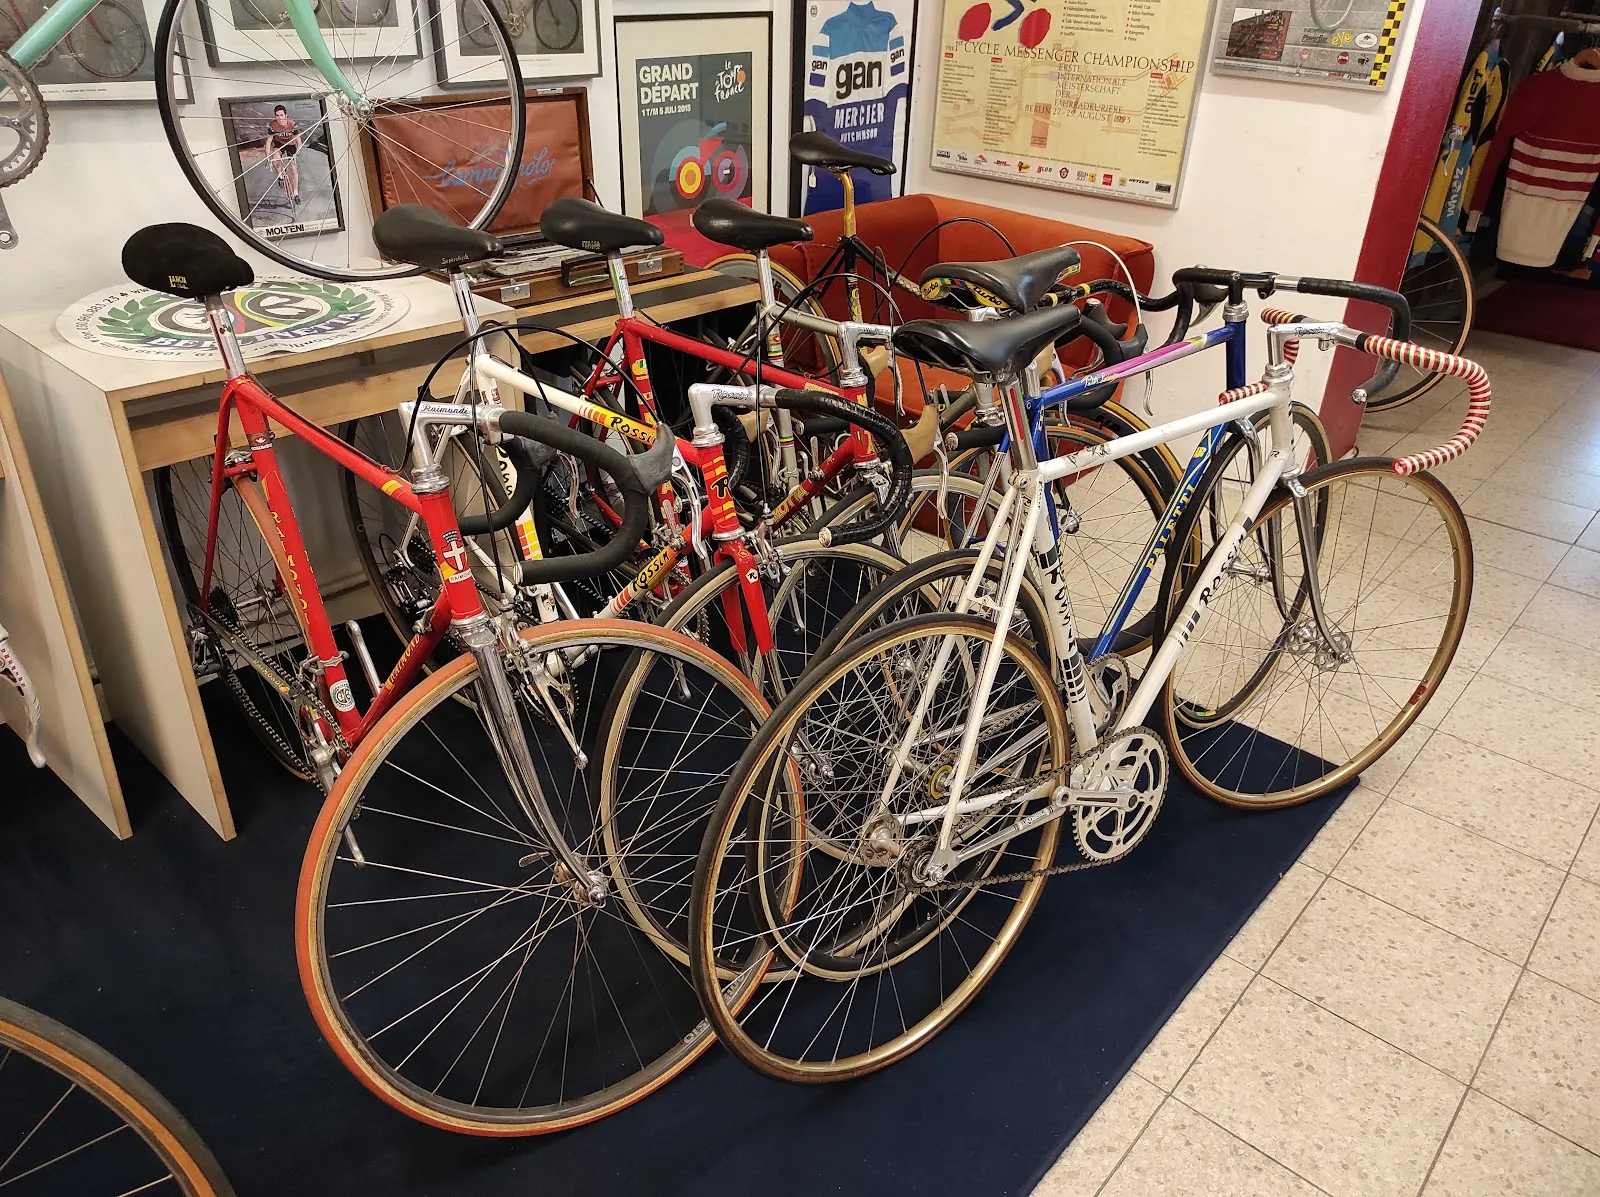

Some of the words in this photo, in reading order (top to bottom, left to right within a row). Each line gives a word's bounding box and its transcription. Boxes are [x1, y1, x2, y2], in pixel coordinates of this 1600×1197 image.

[890, 48, 904, 62] gan
[964, 42, 1000, 55] CYCLE
[1004, 44, 1079, 63] MESSENGER
[1084, 52, 1194, 74] CHAMPIONSHIP
[639, 63, 692, 84] GRAND
[811, 60, 828, 72] gan
[1059, 63, 1082, 72] ERSTE
[835, 58, 882, 100] gan
[1057, 72, 1127, 86] INTERNATIONALE
[639, 82, 698, 105] DÉPART
[1056, 82, 1121, 95] MEISTERSCHAFT
[1056, 90, 1070, 98] DER
[664, 105, 676, 114] JULI
[678, 104, 692, 112] 2015
[1024, 104, 1052, 114] BERLIN
[1077, 112, 1111, 122] AUGUST
[1054, 99, 1124, 114] FAHRRADKURIERE
[834, 102, 884, 130] MERCIER
[422, 147, 555, 190] Campanolo
[266, 224, 304, 236] MOLTENI
[972, 284, 1004, 306] Turbo
[420, 404, 469, 416] Raimondi
[610, 416, 656, 446] Rossi
[1147, 482, 1197, 571] PALETTI
[253, 658, 284, 688] RAIMONDI
